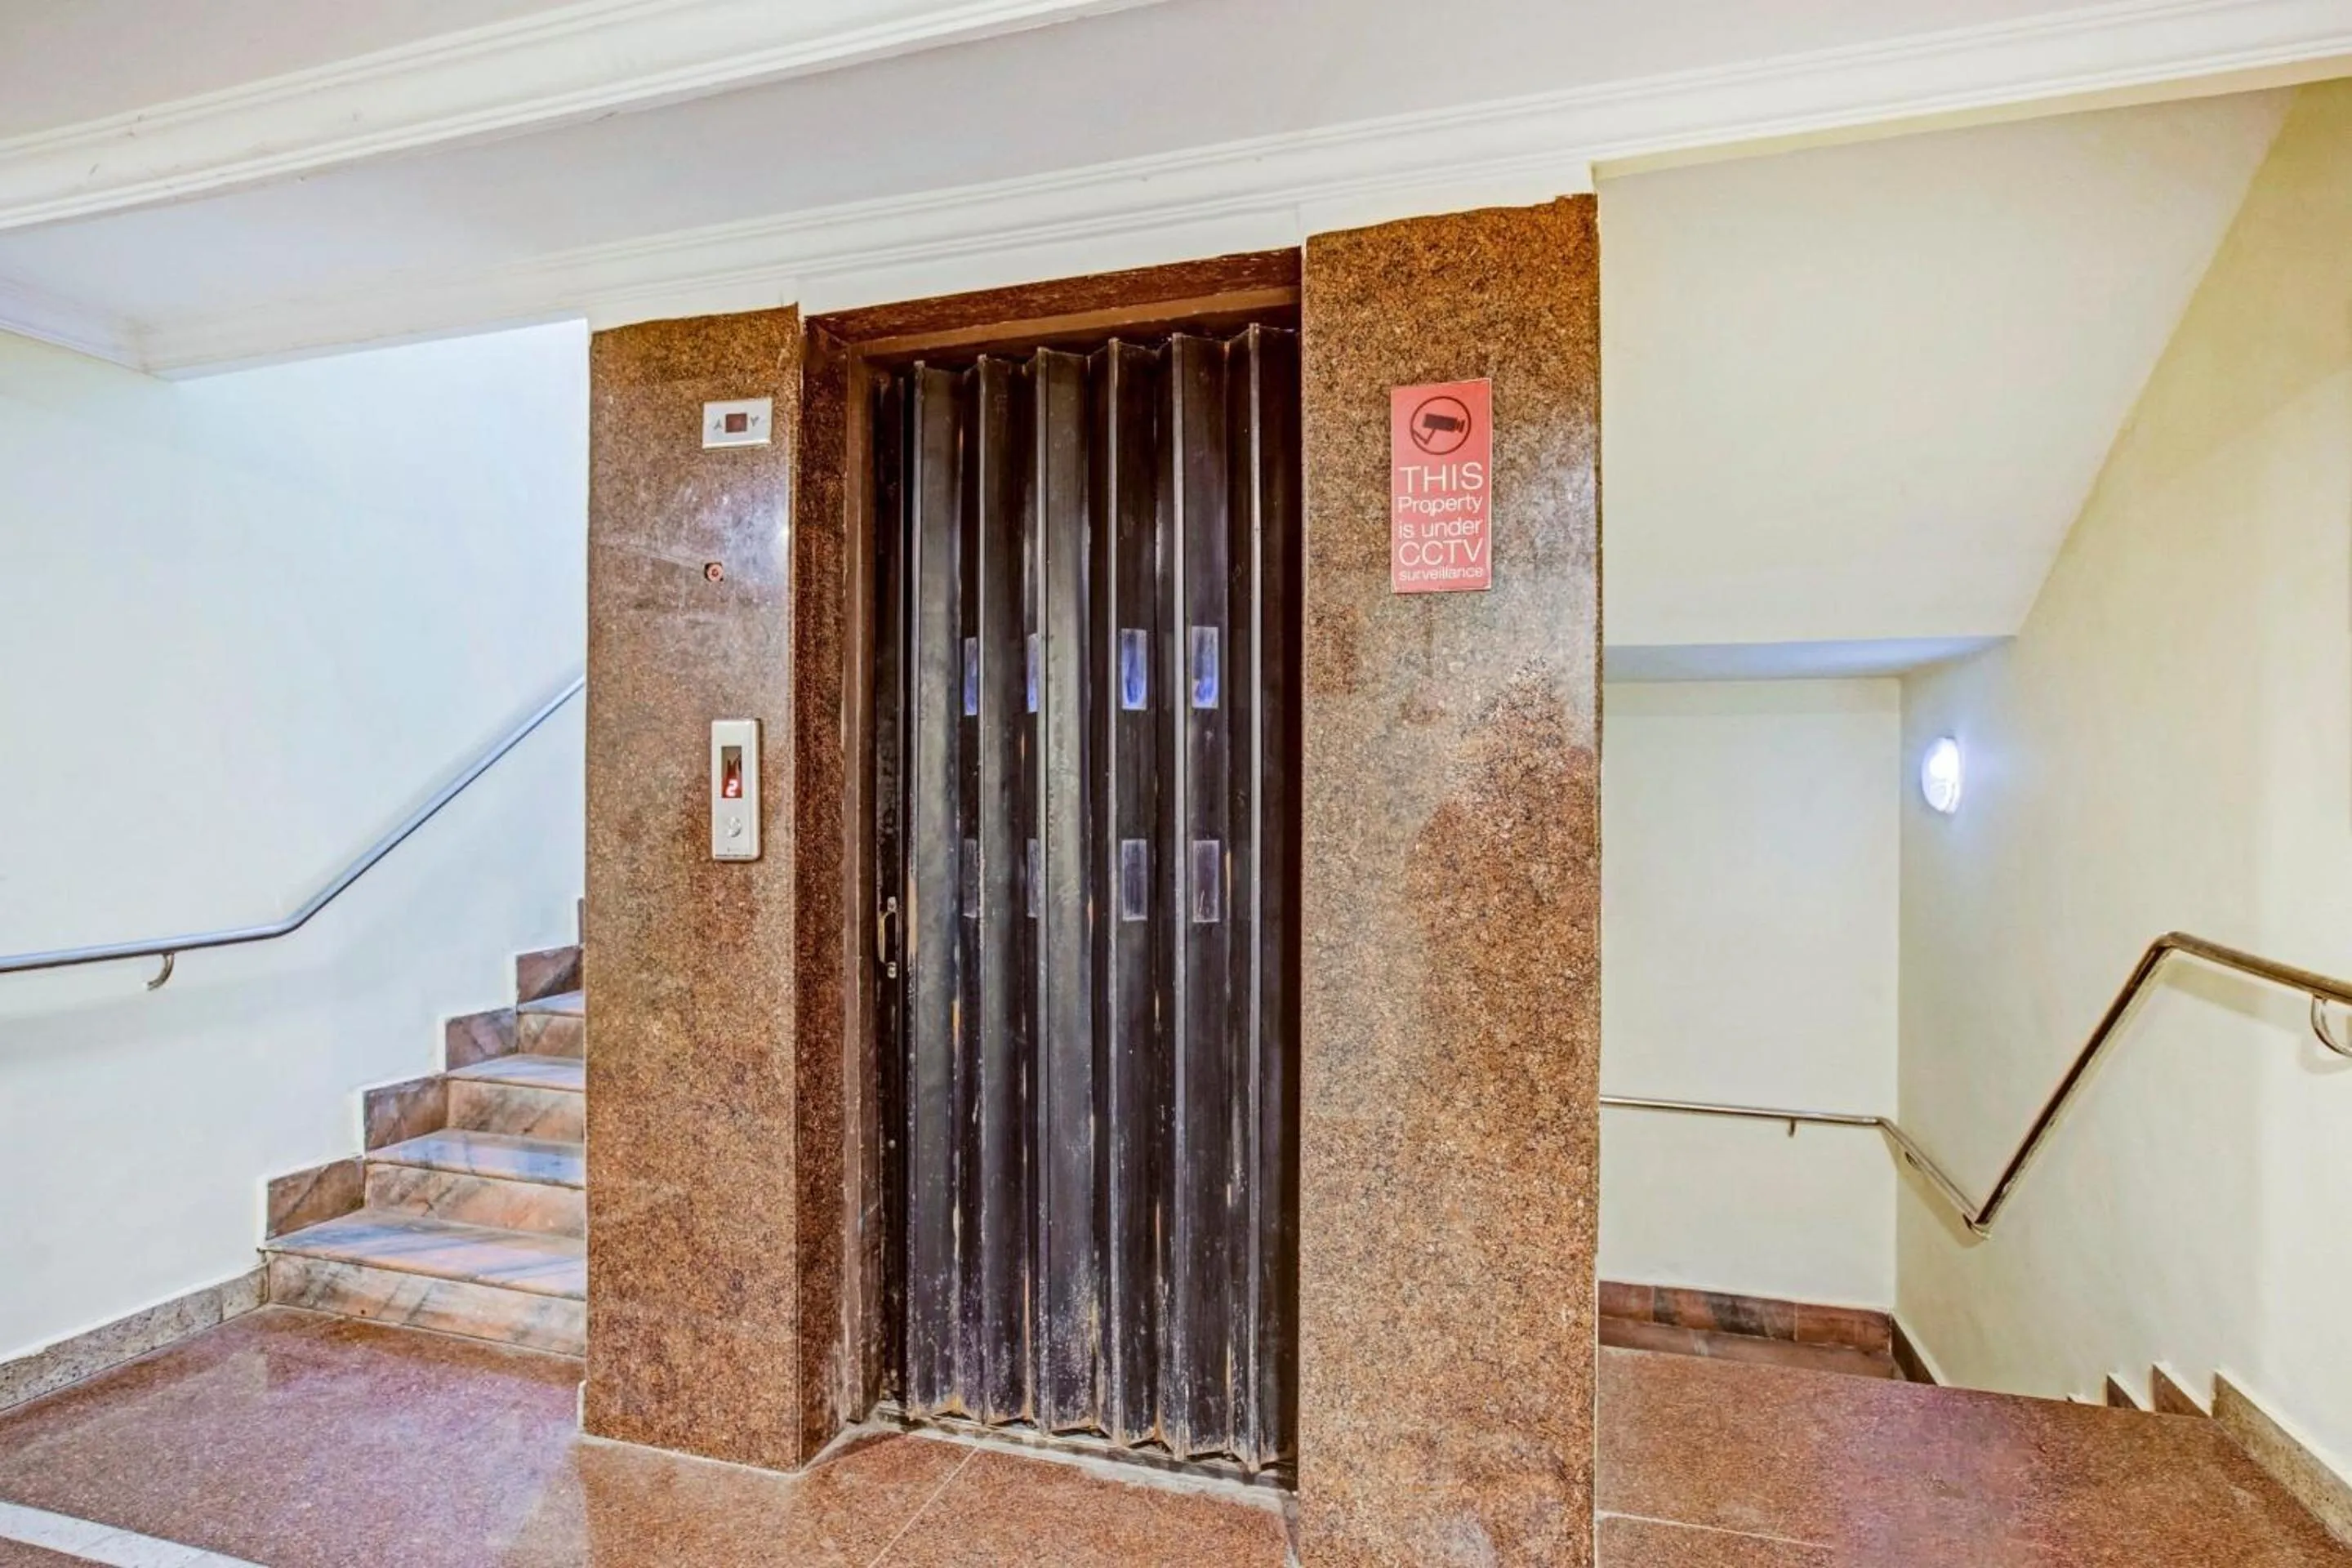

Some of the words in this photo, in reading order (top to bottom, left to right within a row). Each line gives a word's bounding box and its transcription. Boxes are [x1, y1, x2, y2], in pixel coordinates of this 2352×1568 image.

[1399, 462, 1483, 493] THIS
[1398, 494, 1483, 516] Property
[1399, 521, 1414, 539] is
[1421, 518, 1483, 537] under
[1399, 537, 1483, 566] CCTV
[1399, 565, 1483, 581] surveillance
[726, 779, 738, 797] 2
